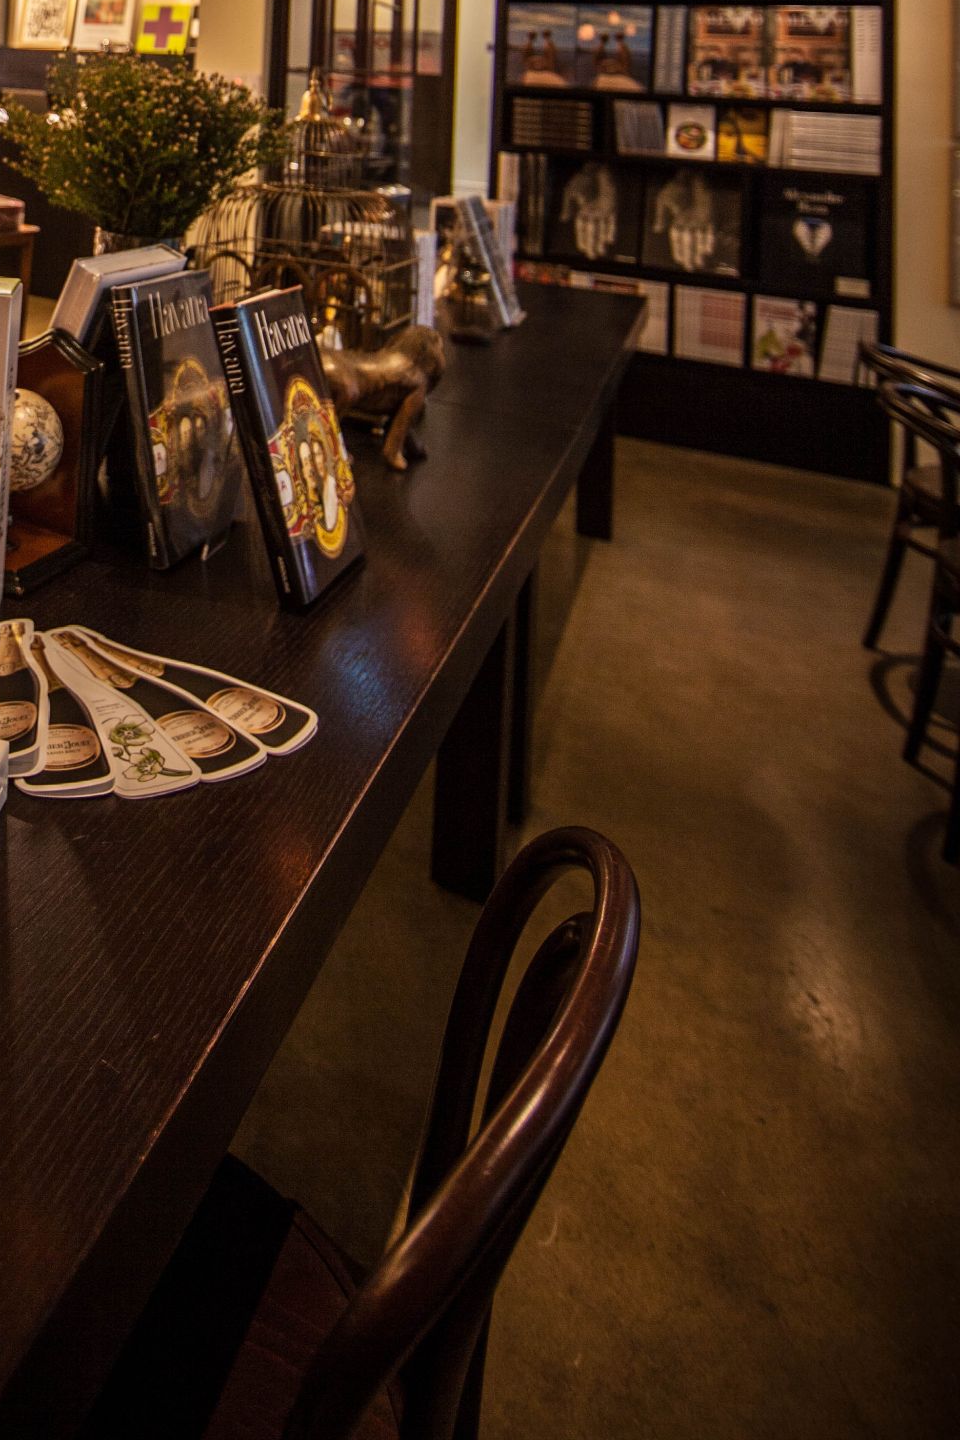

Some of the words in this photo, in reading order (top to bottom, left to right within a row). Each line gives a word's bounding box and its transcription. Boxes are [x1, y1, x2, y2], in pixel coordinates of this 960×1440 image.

[112, 299, 134, 369] Havana
[148, 291, 209, 339] Havana
[254, 310, 312, 360] Havana
[215, 318, 246, 395] Havana
